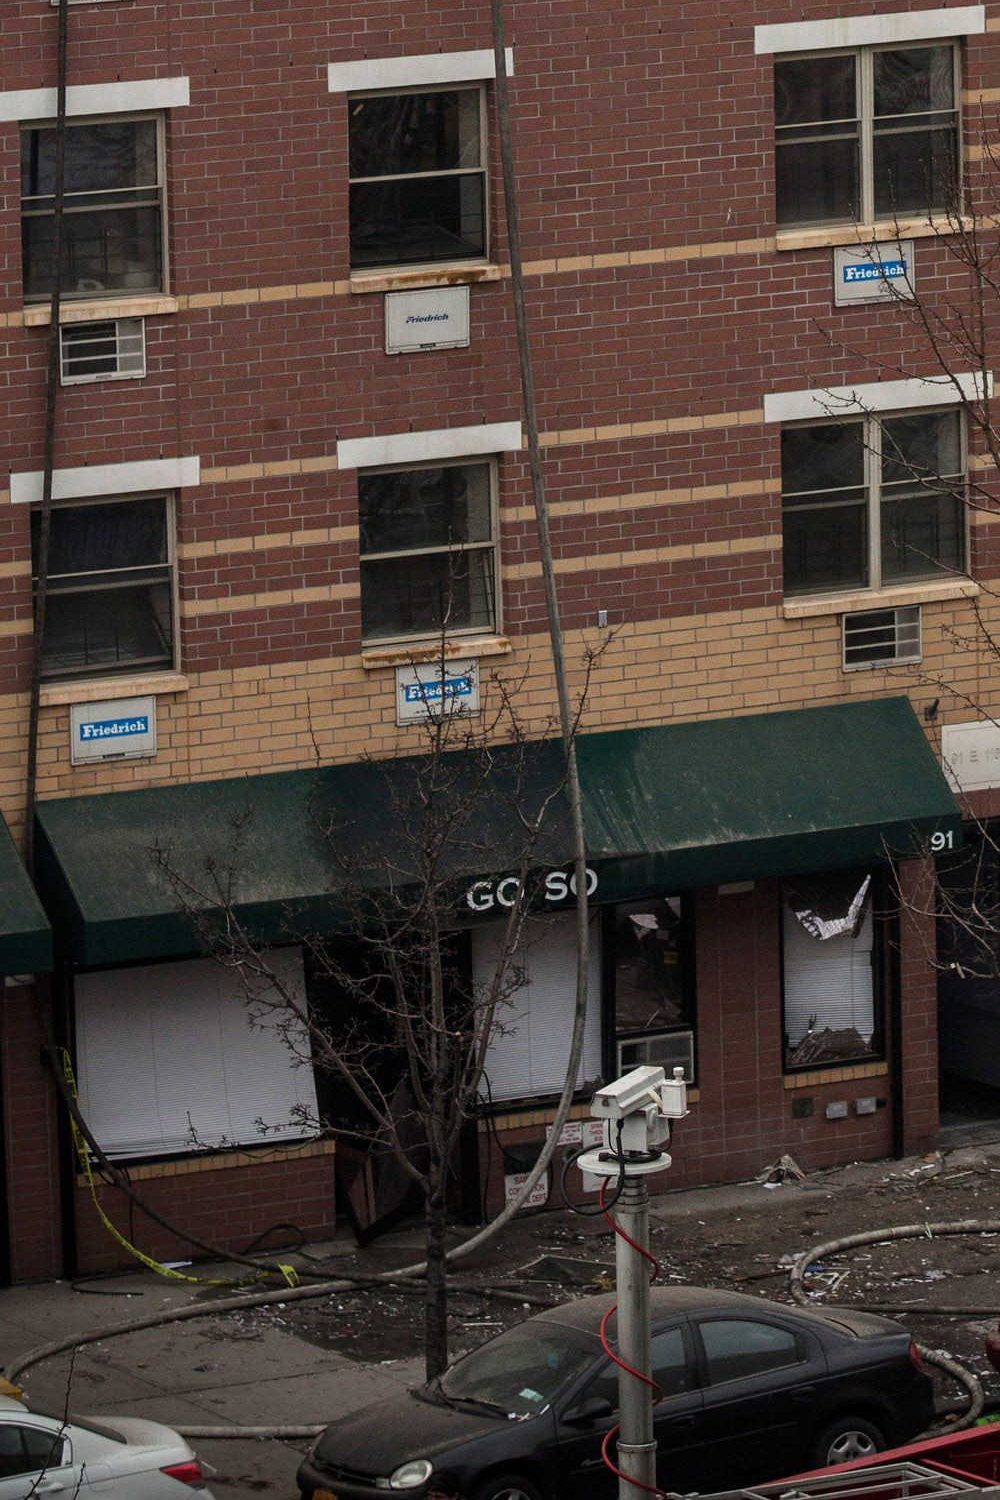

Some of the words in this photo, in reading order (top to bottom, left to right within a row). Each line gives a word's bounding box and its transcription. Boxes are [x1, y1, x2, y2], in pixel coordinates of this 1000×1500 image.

[845, 264, 905, 280] Friedich
[405, 312, 449, 324] Friedrich
[82, 720, 146, 738] Friedrich
[931, 830, 953, 851] 91
[466, 877, 525, 911] GO
[544, 867, 598, 901] SO
